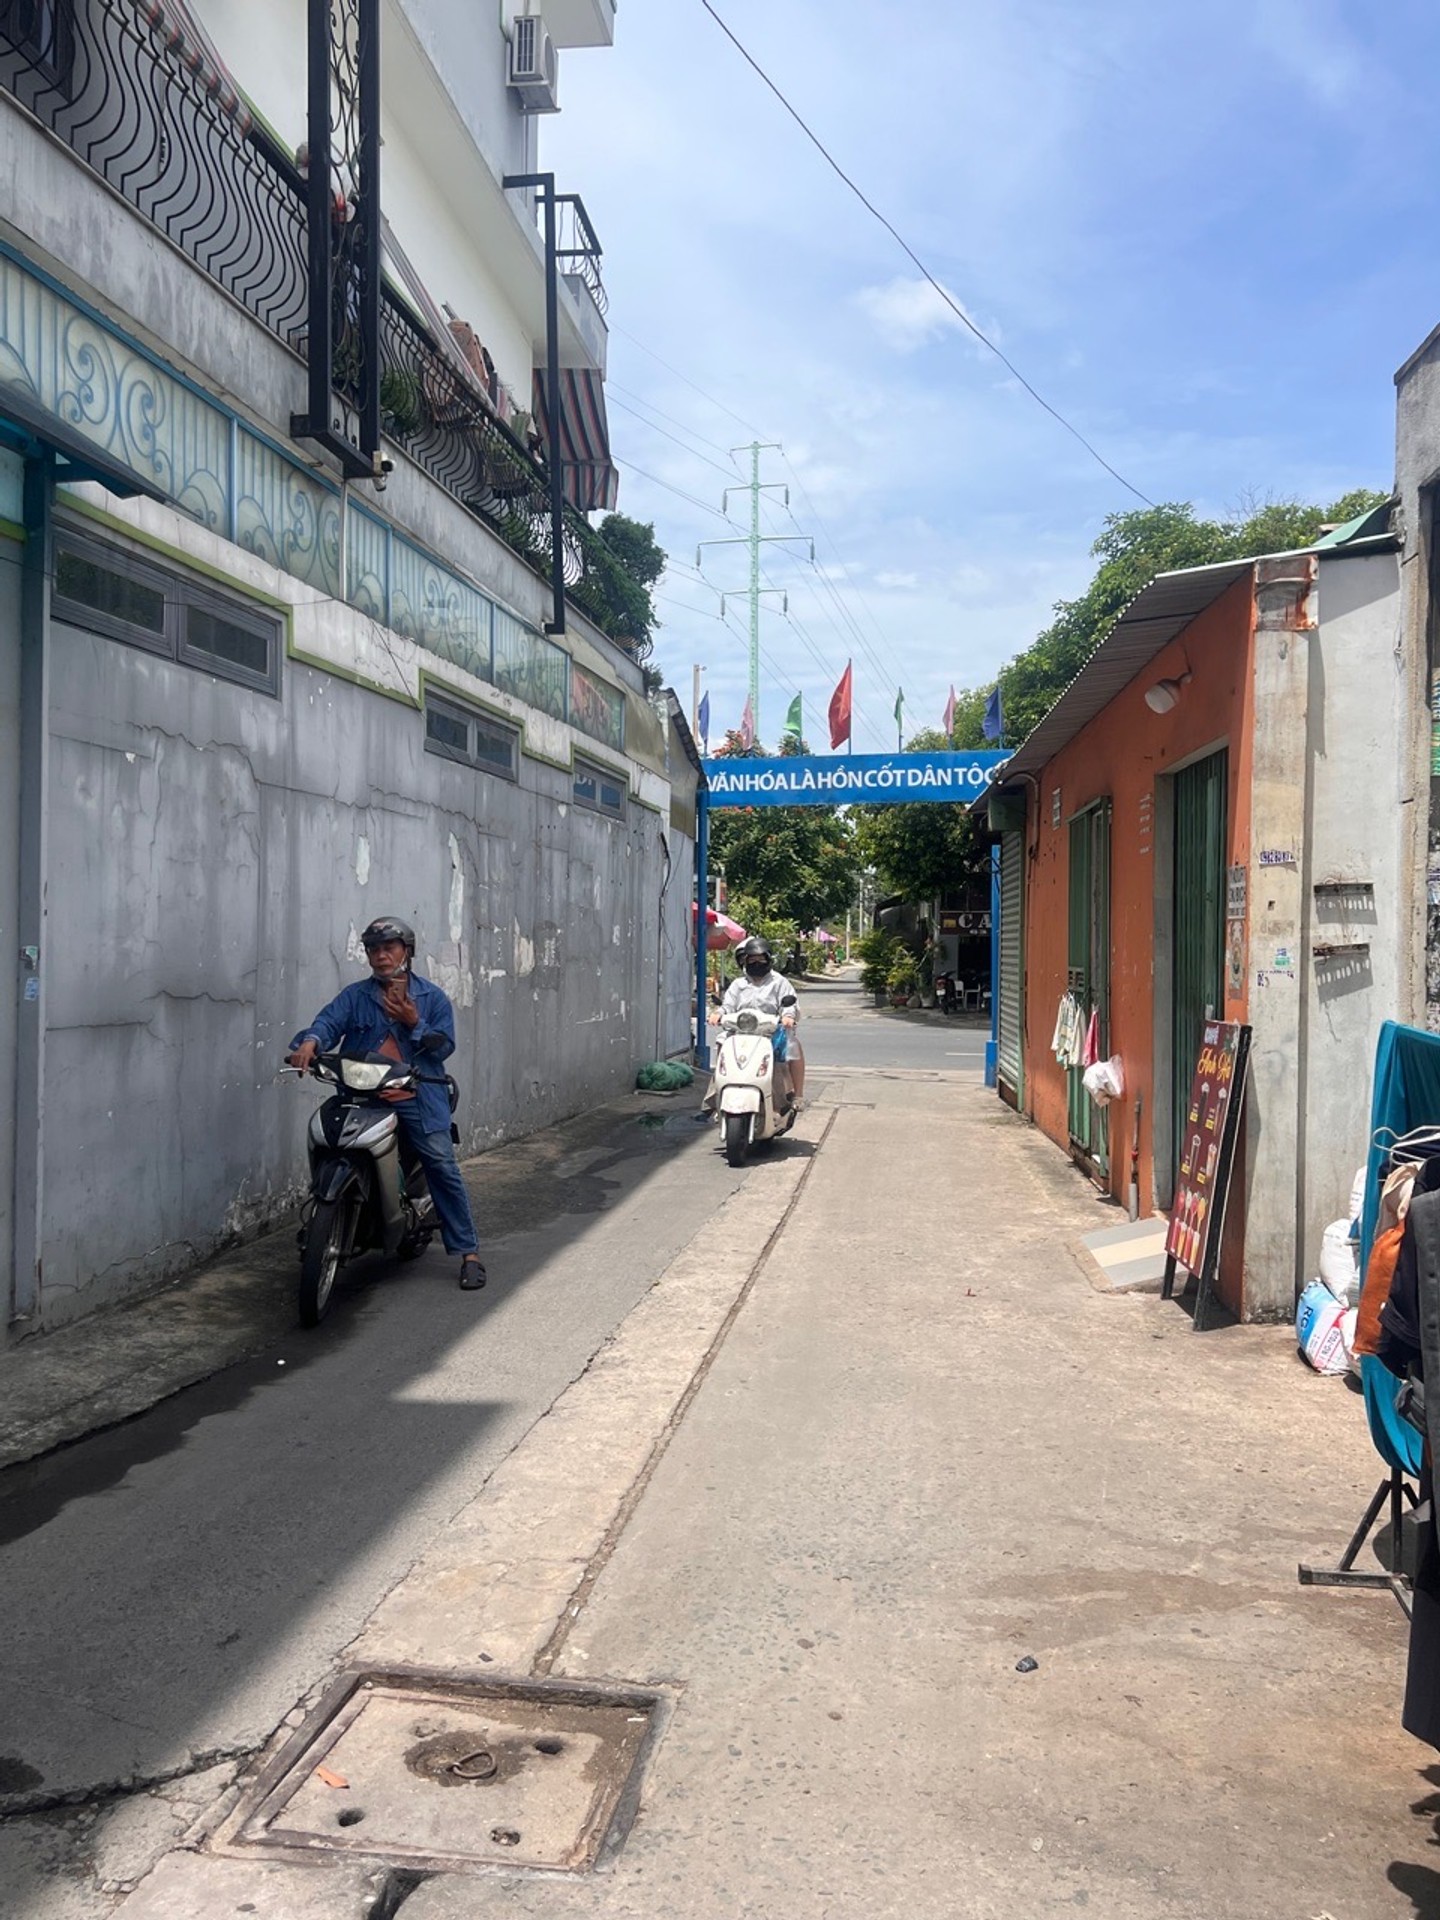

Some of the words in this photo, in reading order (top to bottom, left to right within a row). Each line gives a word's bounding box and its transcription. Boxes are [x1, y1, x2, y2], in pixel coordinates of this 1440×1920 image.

[706, 771, 742, 792] VĂN
[745, 769, 787, 791] HÓA
[791, 768, 816, 790] LÀ
[817, 764, 862, 788] HỒN
[864, 762, 905, 787] CỐT
[907, 764, 952, 786] DÂN
[954, 762, 994, 788] TỘC
